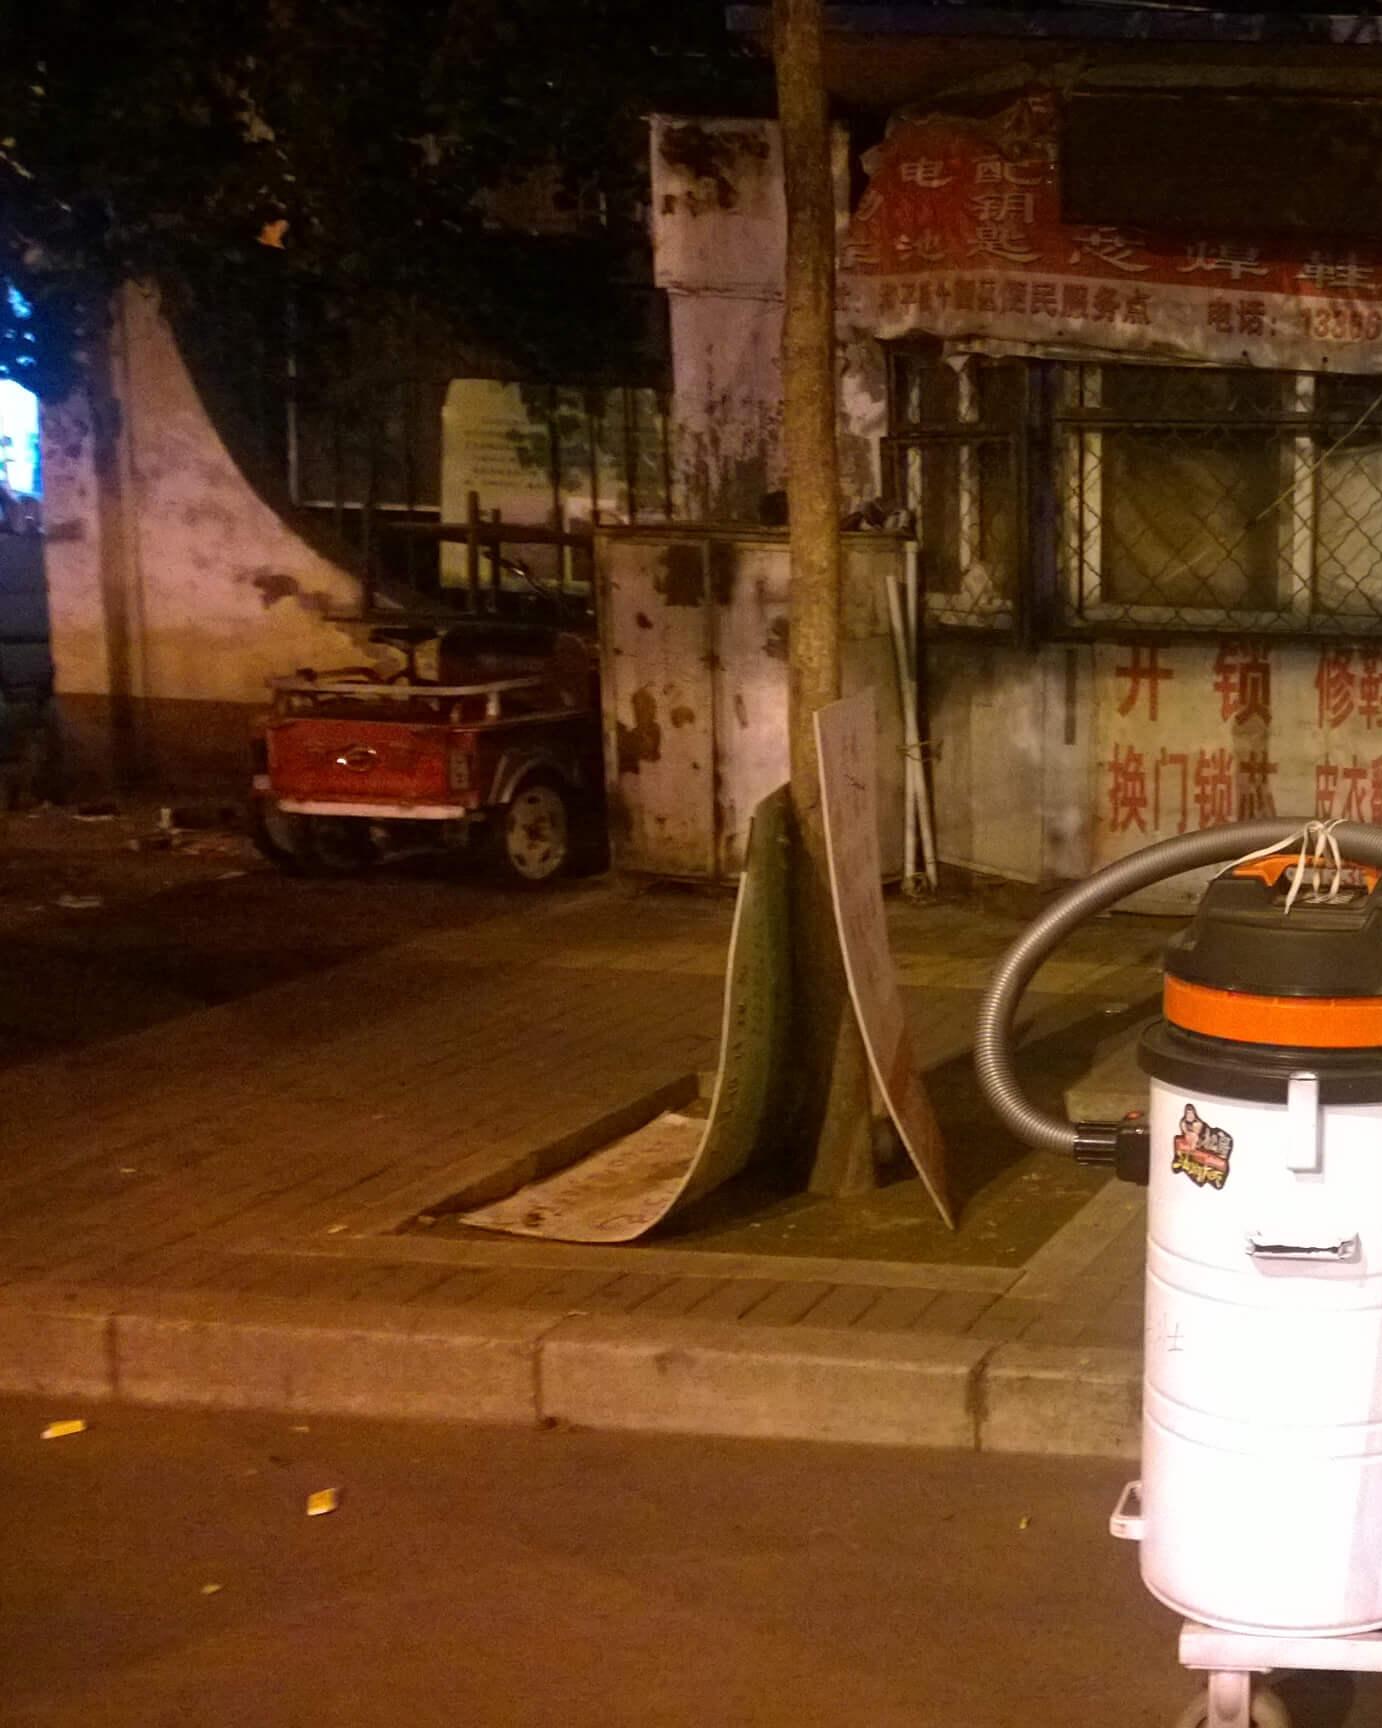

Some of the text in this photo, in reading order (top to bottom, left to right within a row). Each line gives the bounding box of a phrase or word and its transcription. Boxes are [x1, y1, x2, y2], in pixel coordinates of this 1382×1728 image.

[1114, 640, 1274, 727] 开锁
[1107, 742, 1278, 833] 换门锁芯
